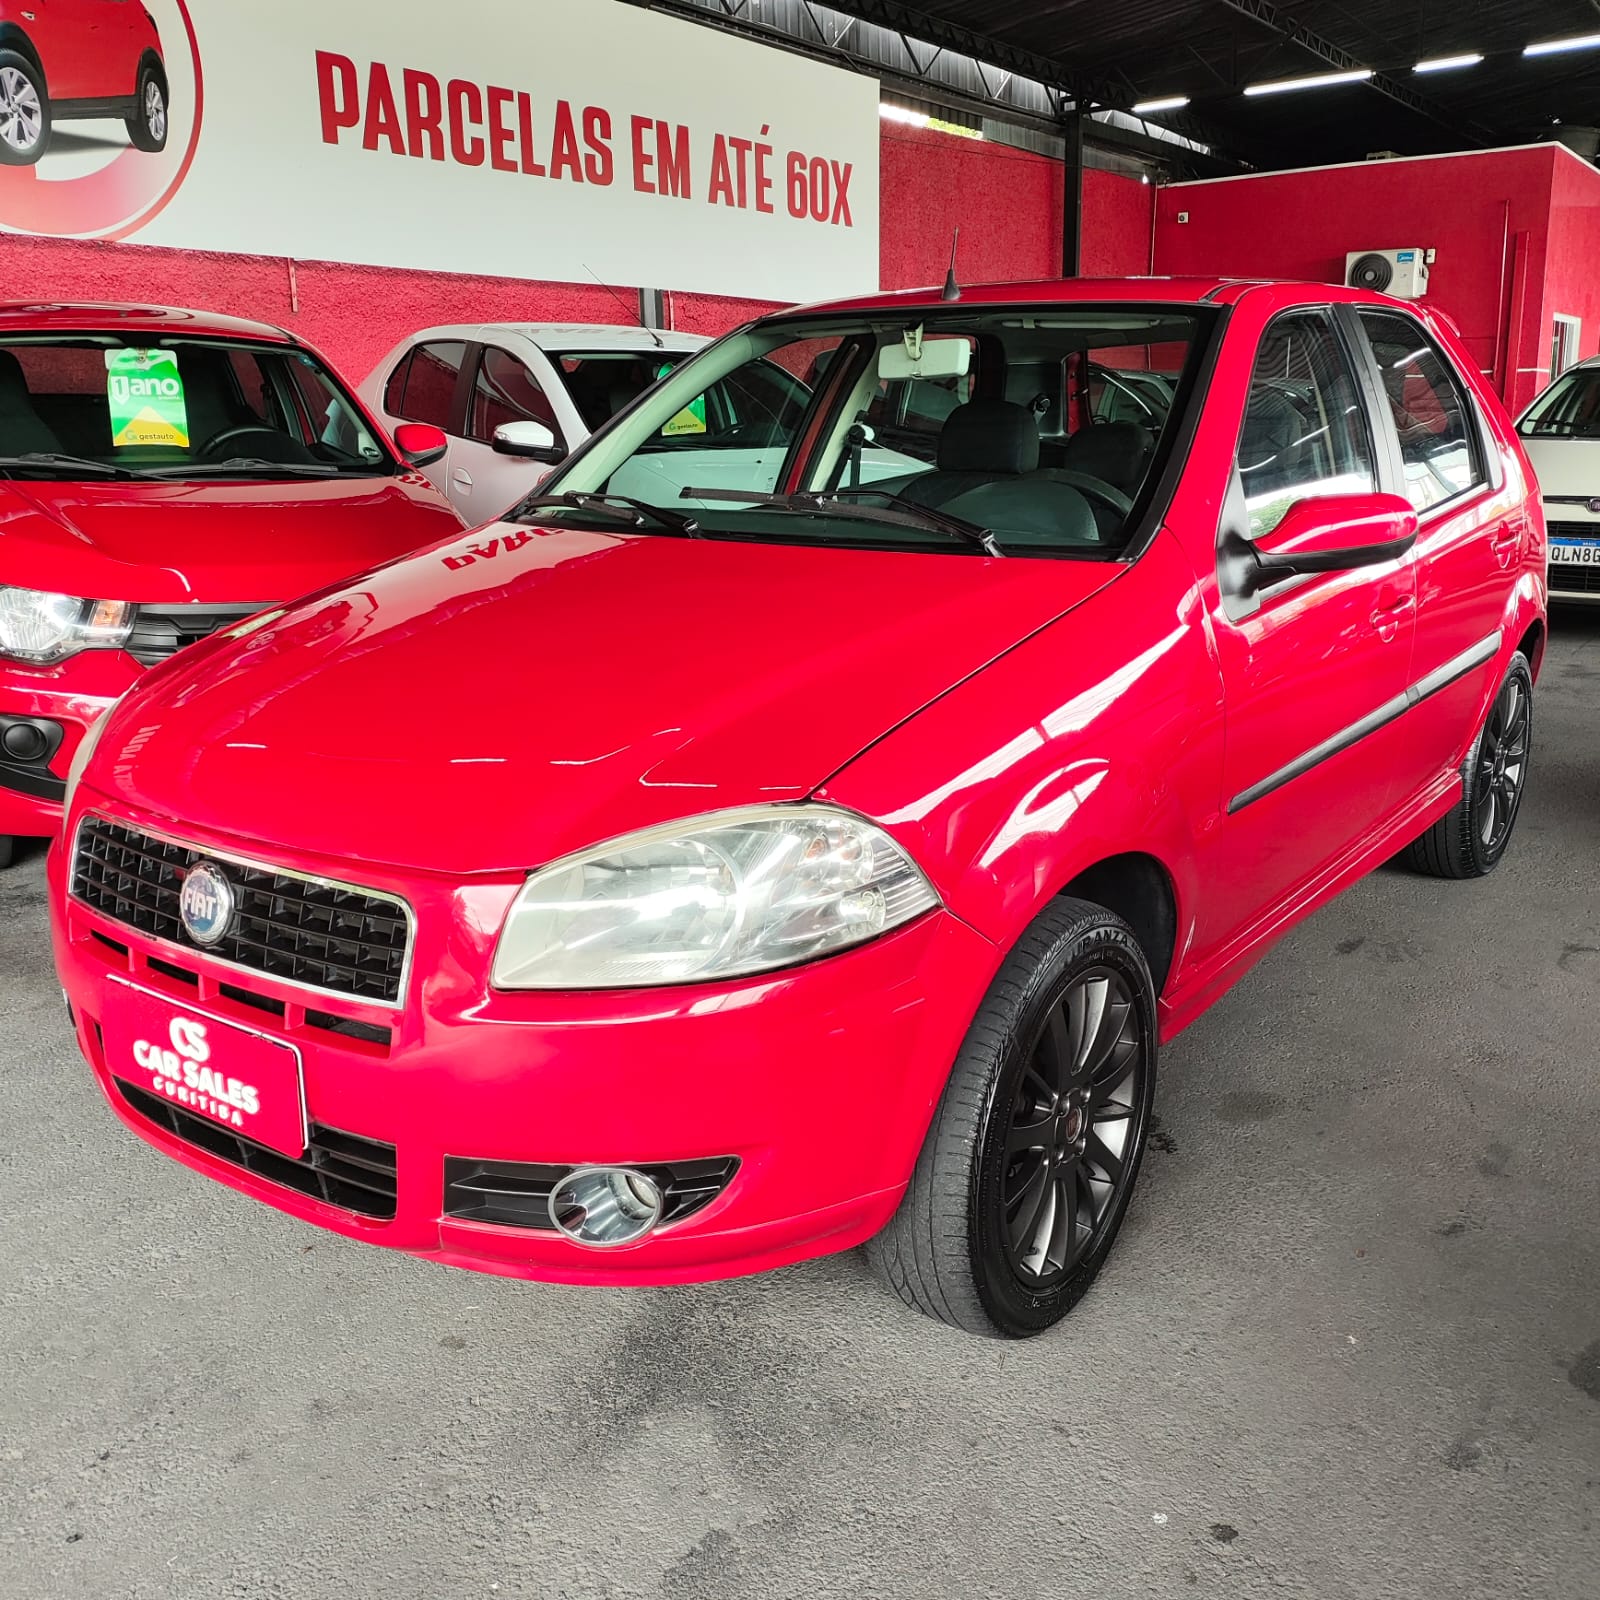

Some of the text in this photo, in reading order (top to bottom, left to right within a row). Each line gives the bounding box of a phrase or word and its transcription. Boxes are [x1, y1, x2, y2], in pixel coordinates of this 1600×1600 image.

[316, 50, 852, 226] PARCELAS EM ATÉ 60X
[130, 378, 180, 396] ano
[138, 433, 175, 441] gestauto
[184, 887, 217, 920] FIAT
[169, 1016, 211, 1062] CS
[132, 1039, 261, 1115] CAR SALES
[152, 1076, 244, 1127] CURITIBA
